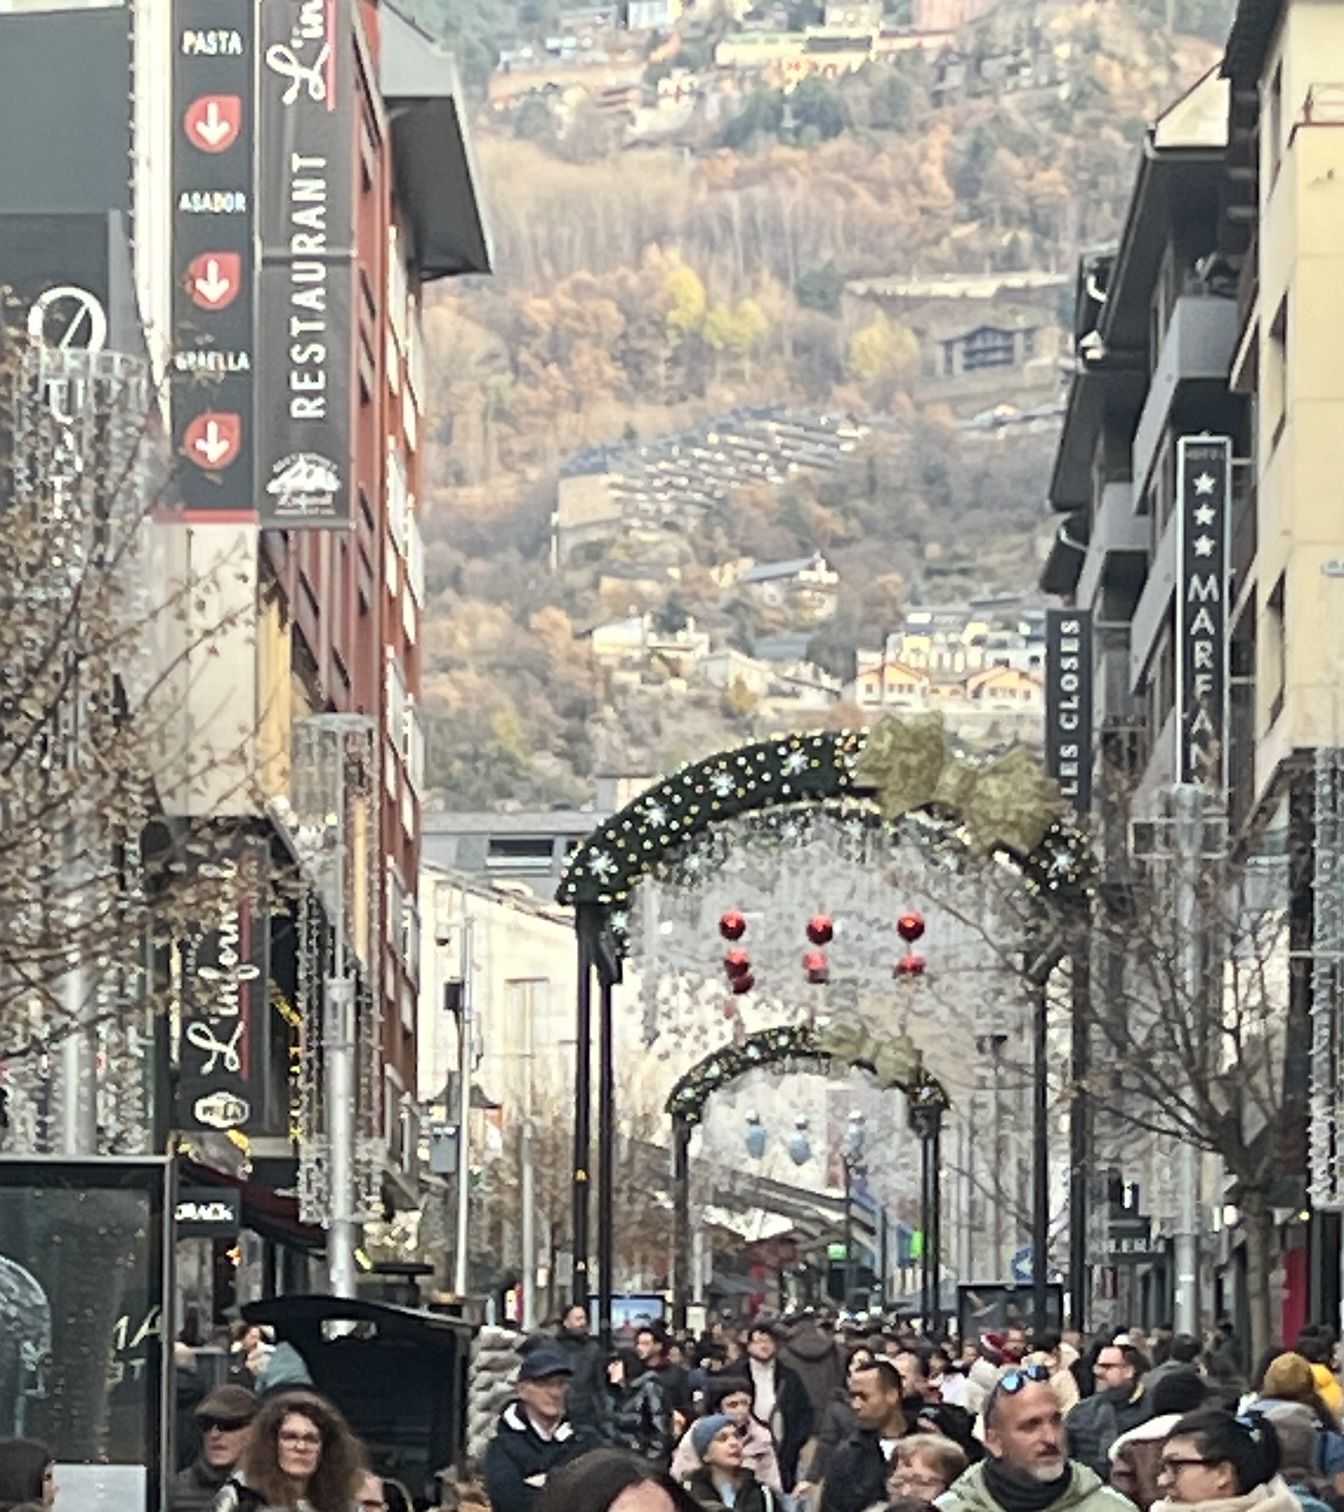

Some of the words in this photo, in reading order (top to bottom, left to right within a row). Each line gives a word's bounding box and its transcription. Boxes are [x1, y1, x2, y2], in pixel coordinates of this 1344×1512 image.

[182, 30, 243, 55] PASTA
[179, 187, 246, 213] ASADOR
[290, 153, 327, 418] RESTAURANT
[1060, 619, 1079, 730] CLOSES
[1061, 744, 1078, 796] LES
